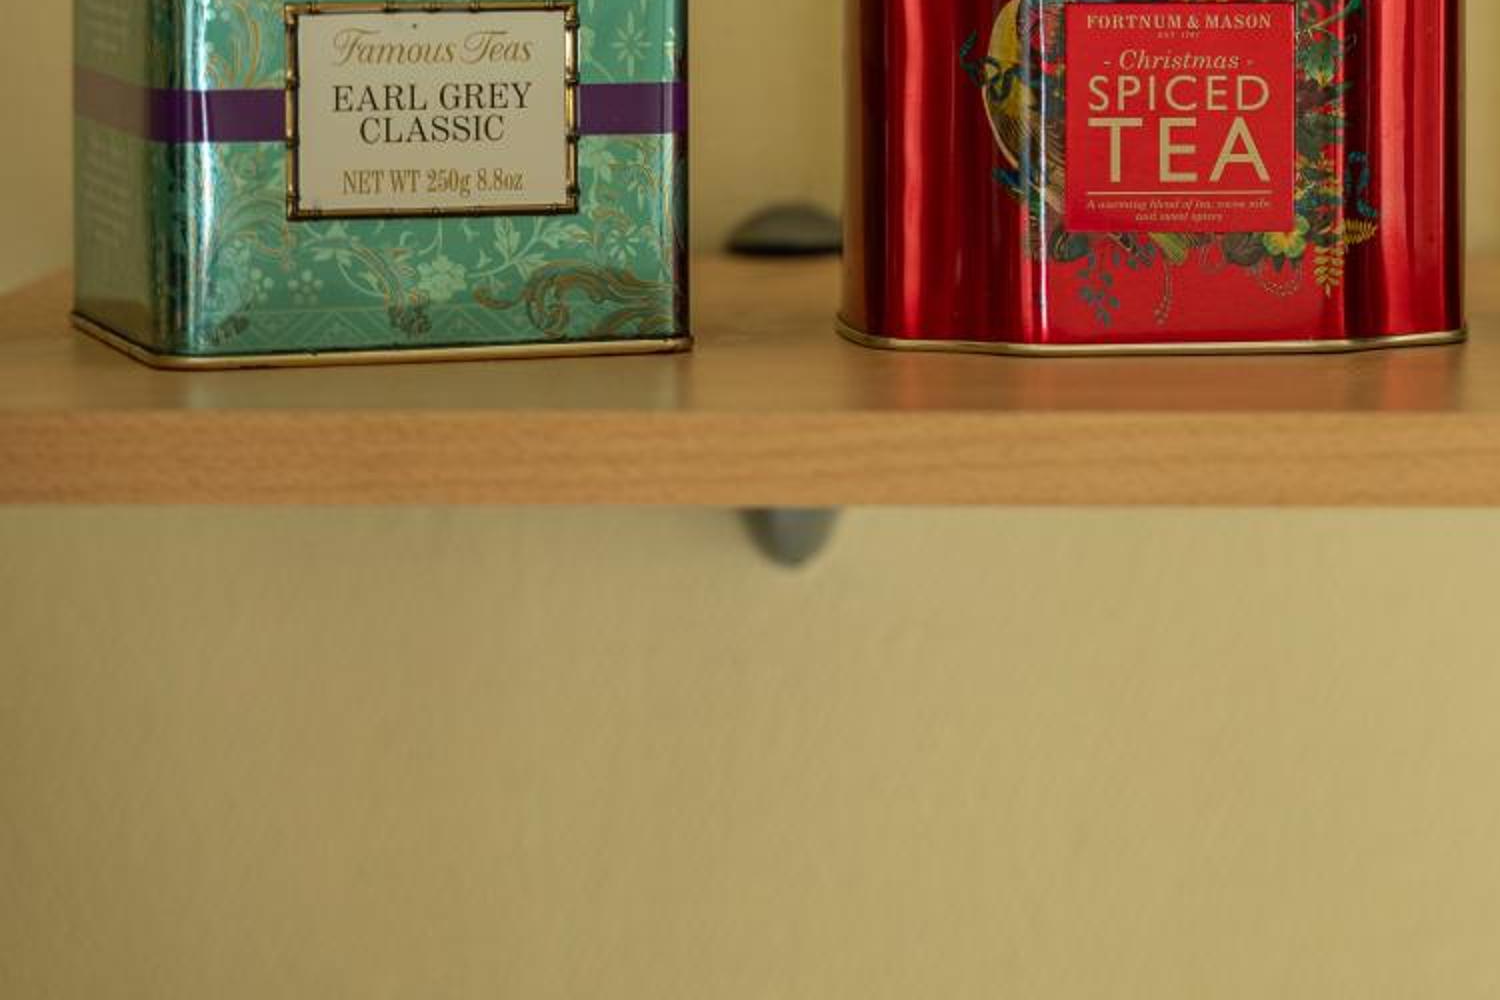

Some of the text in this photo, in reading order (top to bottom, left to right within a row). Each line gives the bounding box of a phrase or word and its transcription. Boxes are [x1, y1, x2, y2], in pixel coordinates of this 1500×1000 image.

[1087, 13, 1272, 29] FORTNUM & MASON
[333, 26, 534, 67] Famous Teas
[1118, 48, 1241, 70] Christmas
[333, 81, 533, 113] EARL GREY
[1088, 74, 1270, 112] SPICED
[359, 115, 505, 145] CLASSIC
[1088, 117, 1271, 183] TEA
[342, 167, 524, 198] NET WT 250g 8.8oz
